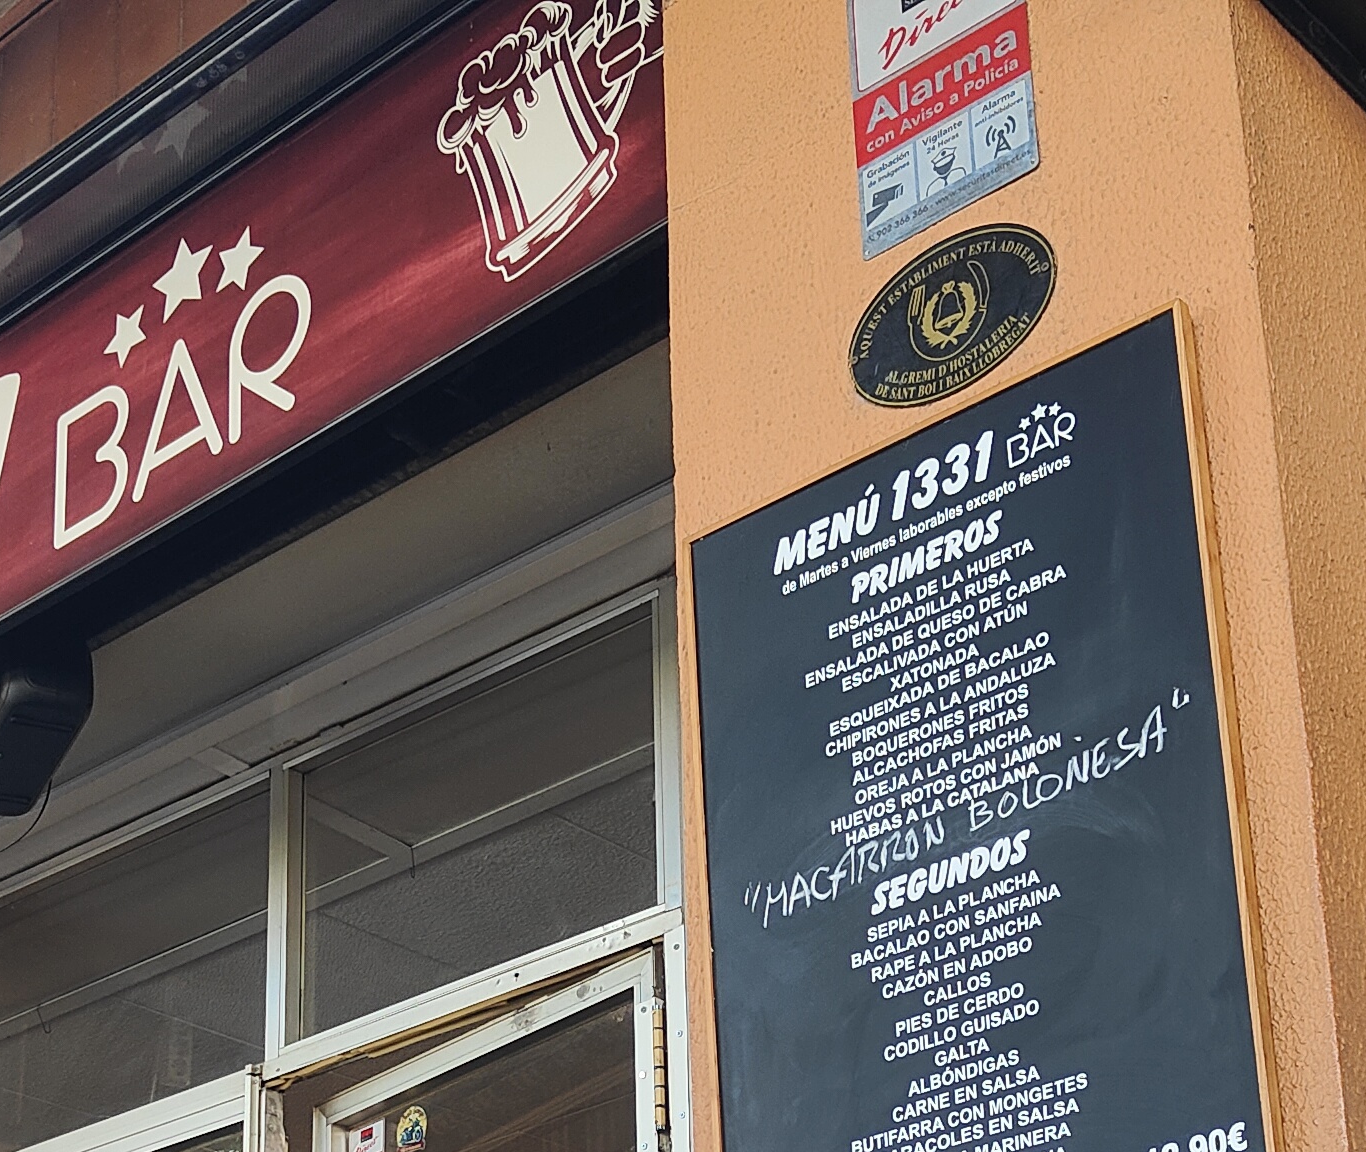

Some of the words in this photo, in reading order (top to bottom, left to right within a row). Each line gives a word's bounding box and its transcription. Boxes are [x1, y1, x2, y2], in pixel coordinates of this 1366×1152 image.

[866, 30, 1017, 134] Alarma
[867, 130, 894, 152] con
[900, 102, 944, 135] Aviso
[949, 93, 958, 105] a
[964, 59, 1018, 97] Policía
[981, 89, 1016, 114] Alarma
[866, 150, 910, 179] Grabación
[921, 119, 963, 147] Vigilante
[53, 274, 312, 550] BAR
[875, 382, 889, 399] DE
[889, 385, 916, 400] SANT
[917, 382, 936, 398] BOI
[945, 367, 972, 389] BAIX
[900, 368, 936, 384] GREMI
[773, 483, 881, 576] MENÚ
[891, 430, 994, 521] 1331
[1006, 412, 1076, 469] BAR
[782, 579, 797, 596] de
[799, 561, 839, 589] Martes
[841, 556, 849, 569] a
[850, 534, 897, 563] Viernes
[898, 504, 964, 543] laborables
[965, 480, 1017, 512] excepto
[1018, 455, 1071, 488] festivos
[851, 509, 1003, 604] PRIMEROS
[829, 681, 935, 737] ESQUEIXADA
[937, 668, 962, 691] DE
[964, 631, 1050, 679] BACALAO
[890, 643, 980, 693] XATONADA
[851, 709, 965, 767] BOQUERONES
[968, 683, 1029, 720] FRITOS
[852, 728, 965, 787] ALCACHOFAS
[968, 703, 1029, 739] FRITAS
[870, 828, 1031, 916] SEGUNDOS
[882, 966, 940, 999] CAZÓN
[943, 957, 967, 980] EN
[969, 936, 1033, 971] ADOBO
[908, 1049, 1020, 1098] ALBÓNDIGAS
[988, 1114, 1013, 1136] EN
[1017, 1097, 1080, 1127] SALSA
